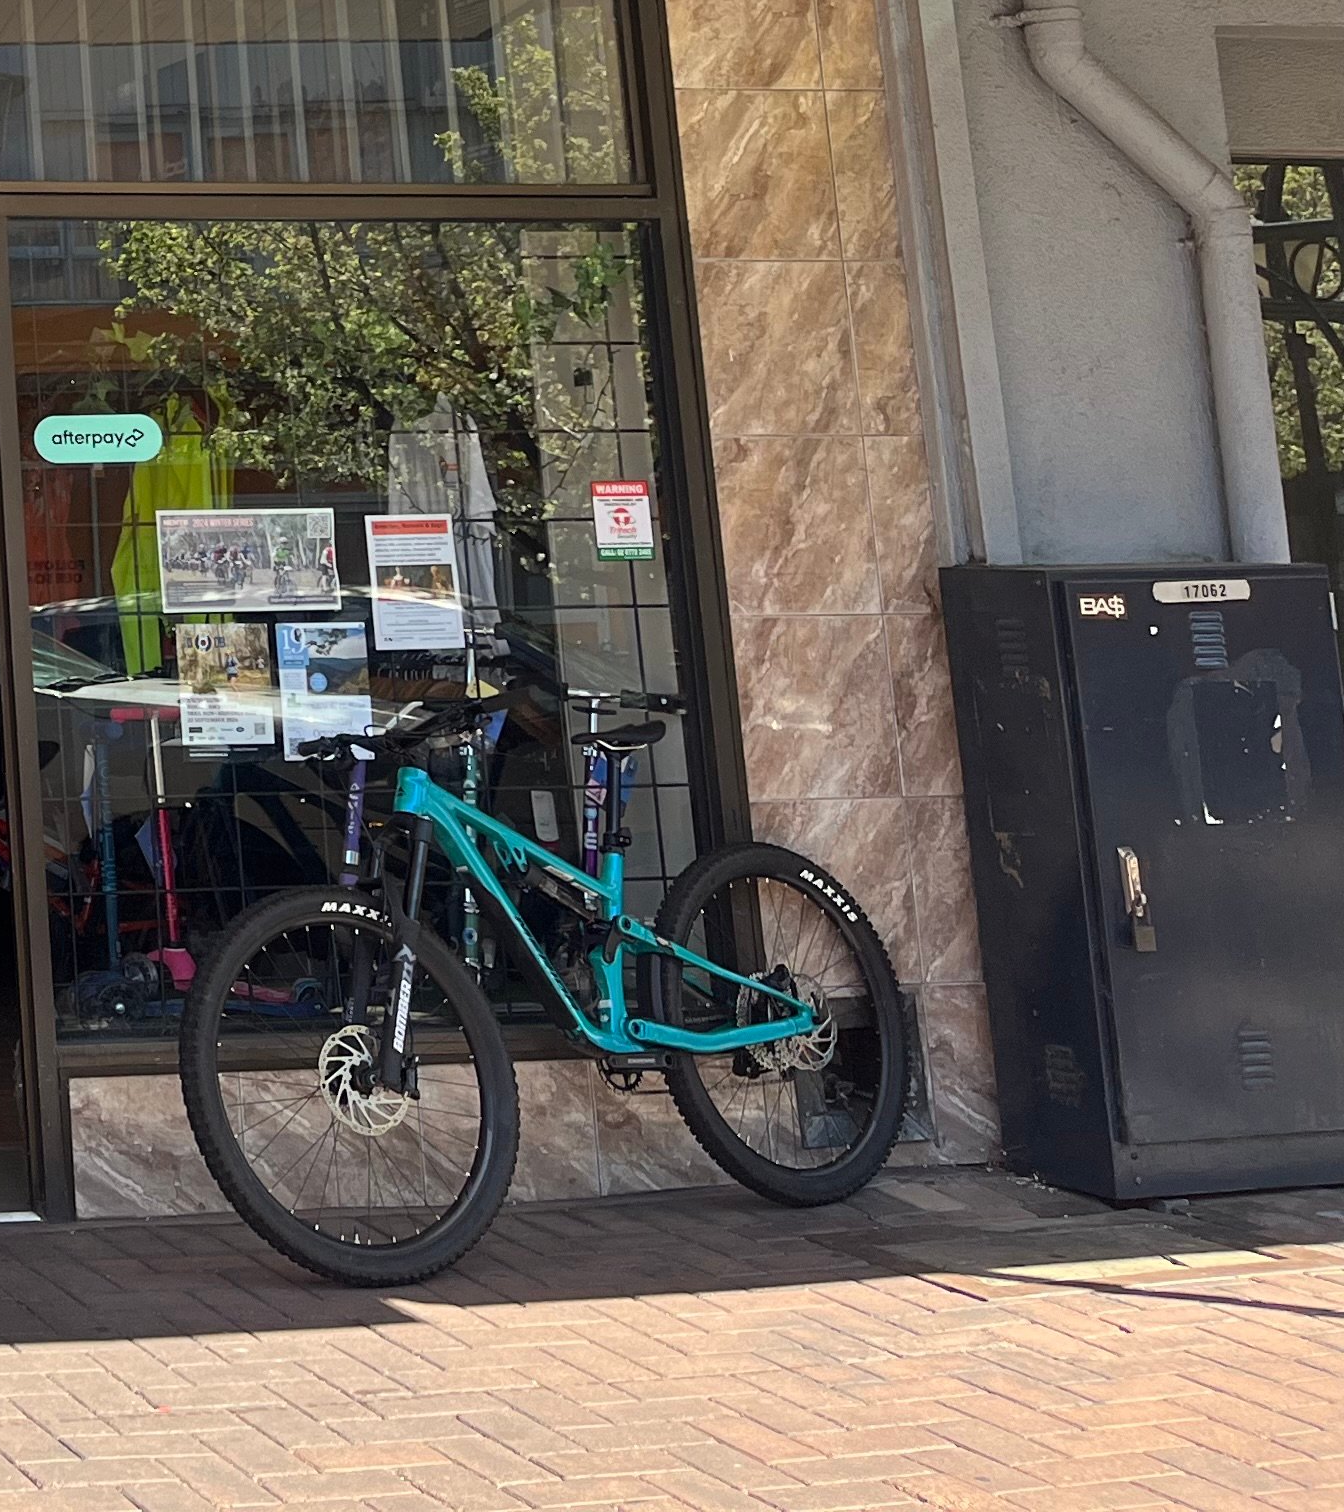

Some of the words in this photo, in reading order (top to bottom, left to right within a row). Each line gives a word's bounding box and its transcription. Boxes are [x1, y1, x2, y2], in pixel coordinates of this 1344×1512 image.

[51, 428, 124, 449] afterpay
[595, 484, 643, 494] WARNING
[1184, 584, 1227, 598] 17062
[800, 869, 858, 922] MAXXIS
[321, 901, 393, 927] MAXX
